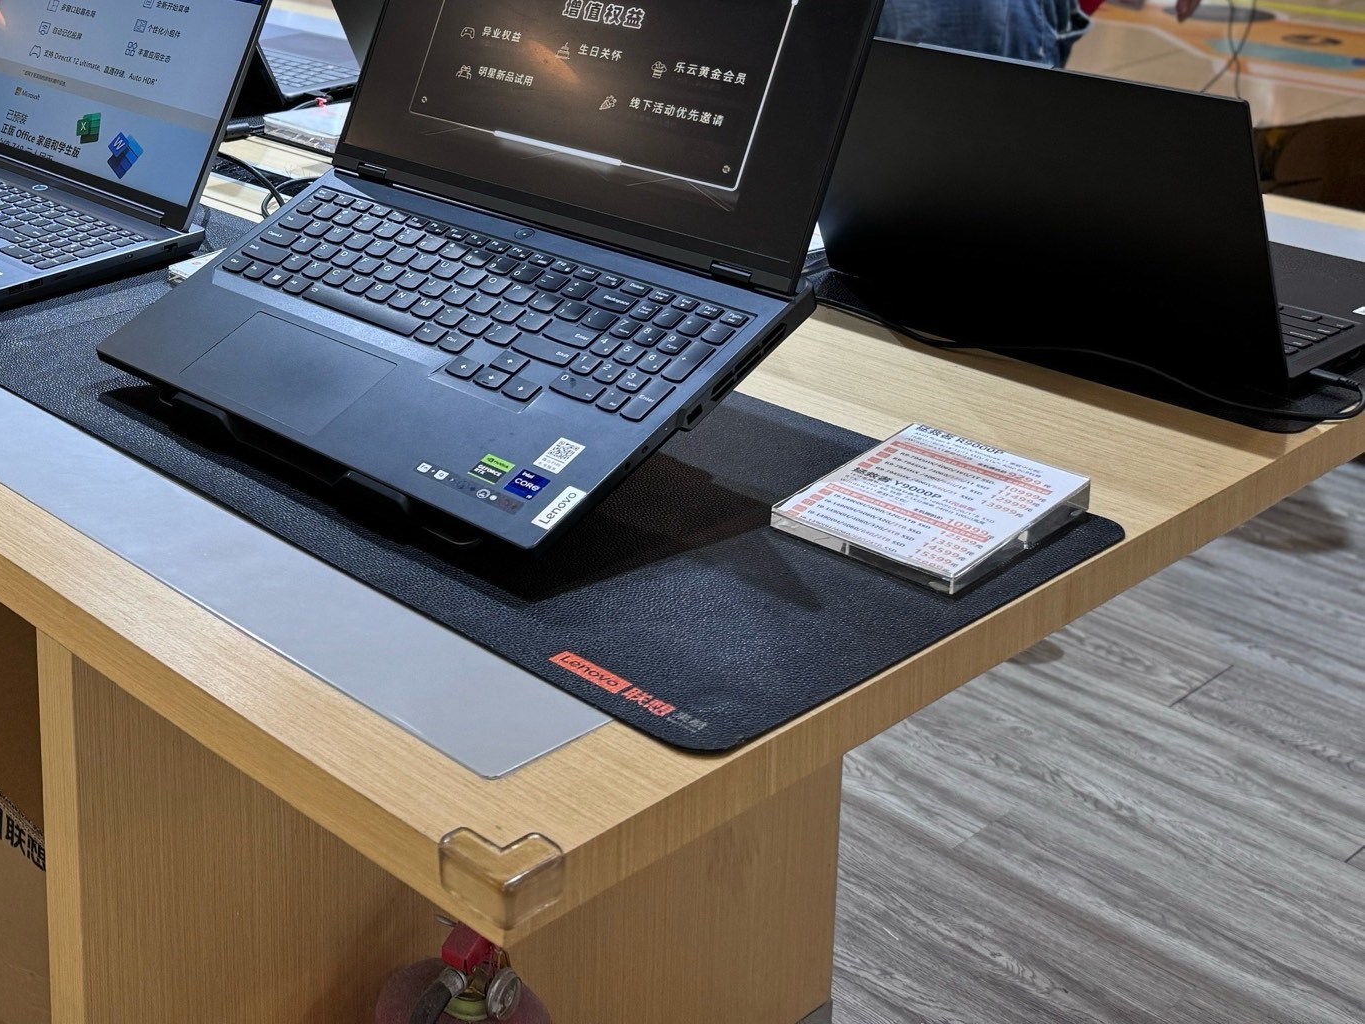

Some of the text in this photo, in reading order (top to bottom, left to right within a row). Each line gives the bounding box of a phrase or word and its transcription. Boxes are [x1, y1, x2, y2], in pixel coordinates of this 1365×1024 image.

[154, 0, 190, 14] 全新开始菜单
[146, 23, 181, 39] 个性化小组件
[481, 26, 522, 43] 异业权益
[577, 43, 623, 62] 生日关怀
[43, 49, 54, 58] 支持
[53, 52, 72, 63] DirectX
[71, 57, 79, 65] 12
[127, 72, 142, 82] Auto
[672, 60, 748, 86] 乐云黄金会员
[476, 65, 534, 87] 明星新品试用
[20, 89, 41, 101] Microsoft
[4, 108, 28, 125] 已预装
[627, 96, 725, 127] 线下活动优先邀请
[79, 120, 88, 132] X
[0, 122, 81, 158] 正版 Office 家庭和学生版
[112, 135, 126, 151] W
[604, 295, 629, 305] Backspace
[639, 393, 656, 405] Enter
[916, 425, 954, 441] 拯救者
[956, 434, 1004, 455] R9000P
[477, 464, 503, 477] GEFORCE
[1007, 472, 1041, 484] 9299
[852, 467, 891, 482] 拯救者
[893, 481, 941, 499] Y9000P
[539, 492, 577, 525] Lenovo
[560, 655, 676, 717] Lenovo 联想
